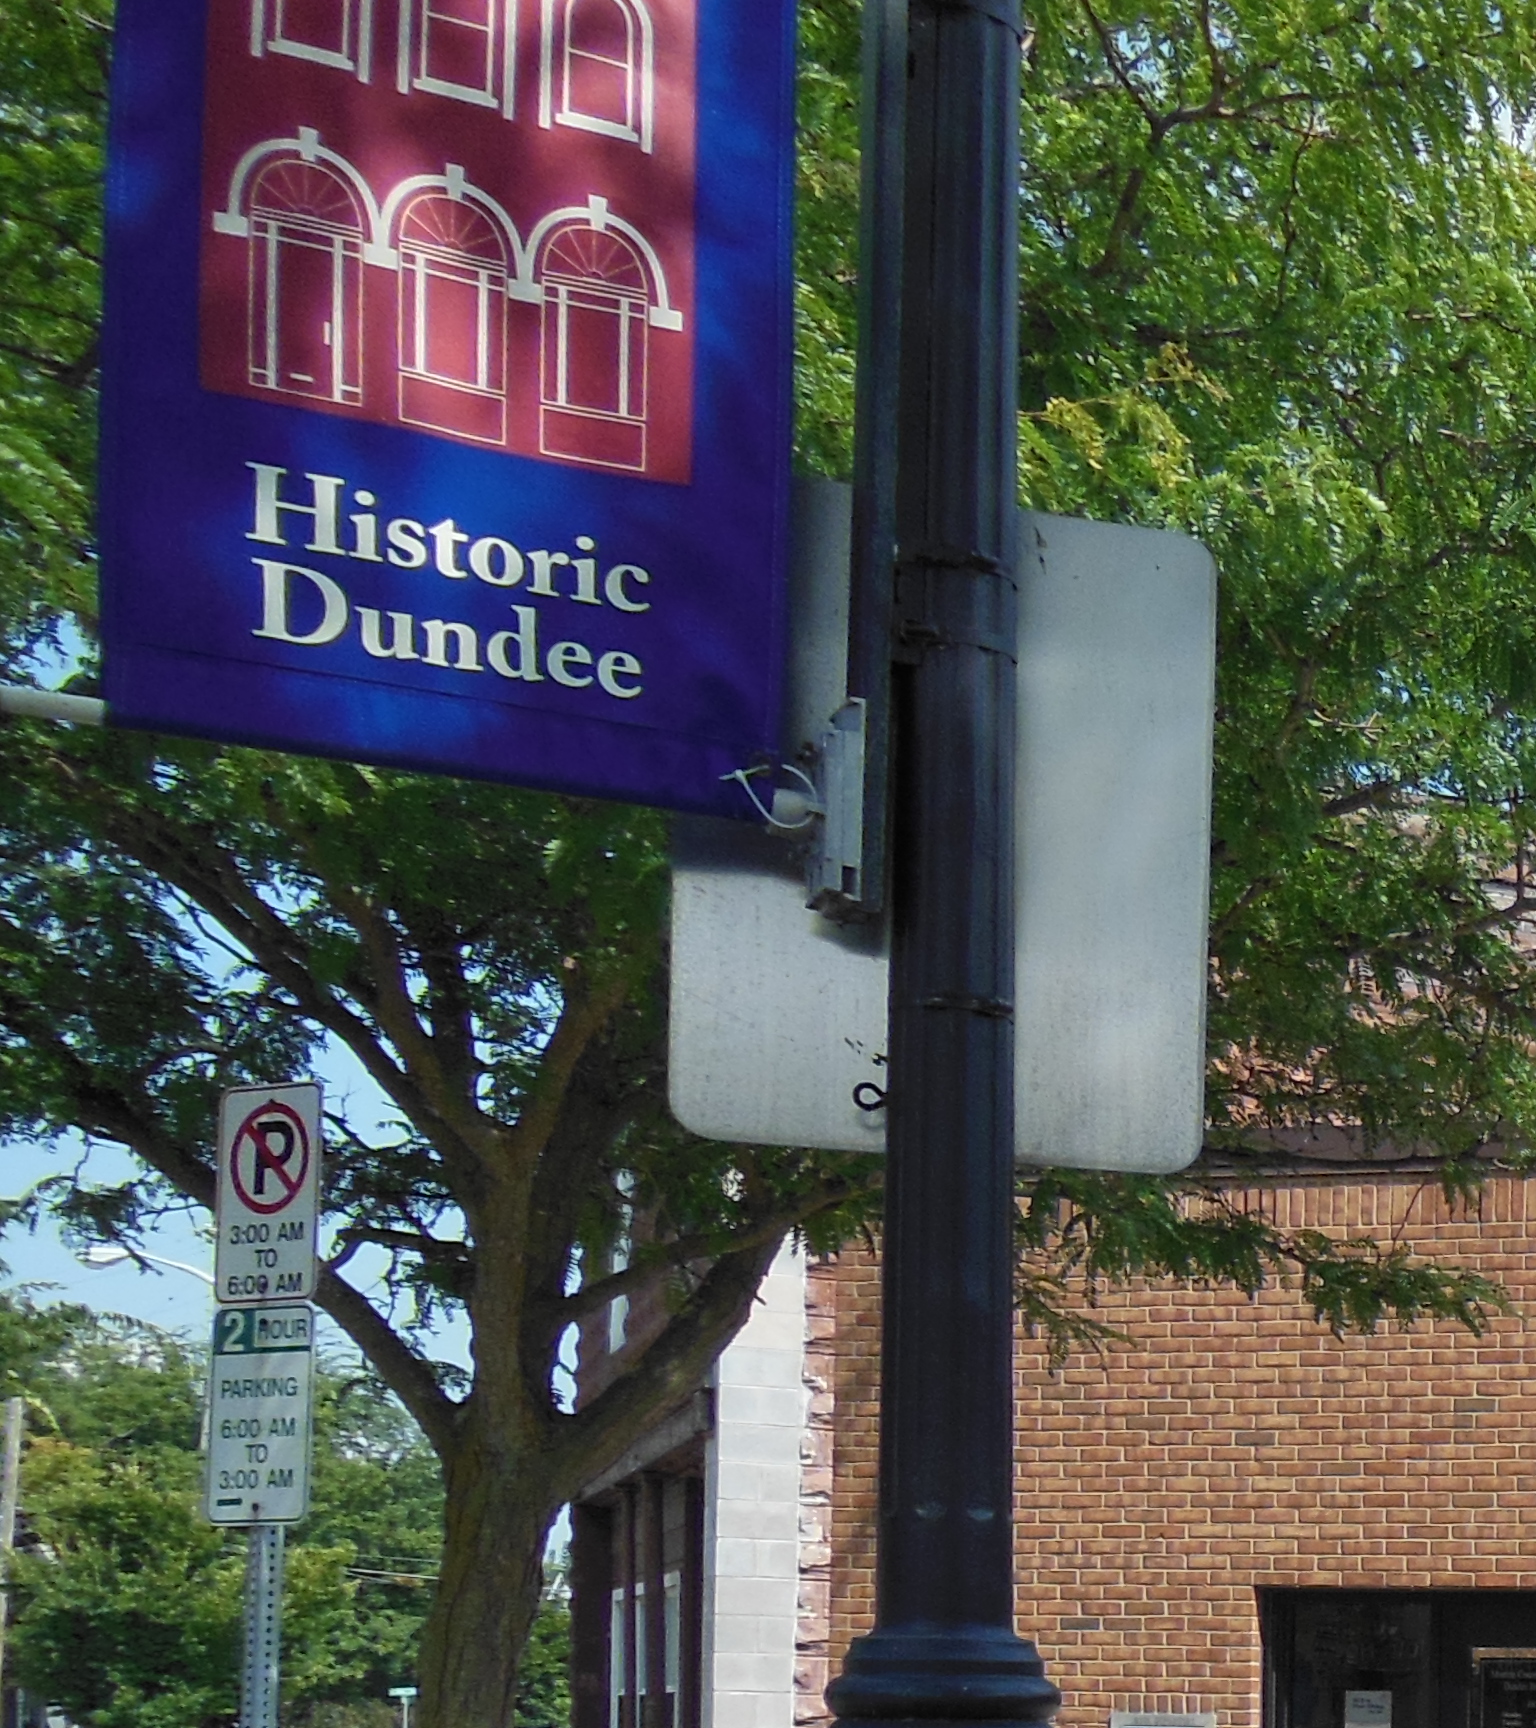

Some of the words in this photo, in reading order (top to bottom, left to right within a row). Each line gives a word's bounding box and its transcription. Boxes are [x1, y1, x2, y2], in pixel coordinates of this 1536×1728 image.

[243, 462, 651, 613] Historic
[251, 558, 646, 700] Dundee
[229, 1223, 270, 1245] 3:00
[276, 1221, 305, 1242] AM
[254, 1248, 278, 1269] TO
[227, 1275, 269, 1296] 6:00
[275, 1272, 304, 1293] AM
[222, 1310, 245, 1353] 2
[257, 1318, 308, 1340] HOUR
[220, 1376, 299, 1399] PARKING
[220, 1418, 261, 1439] 6:00
[268, 1417, 296, 1437] AM
[245, 1443, 268, 1464] TO
[219, 1470, 259, 1490] 3:00
[266, 1468, 294, 1488] AM
